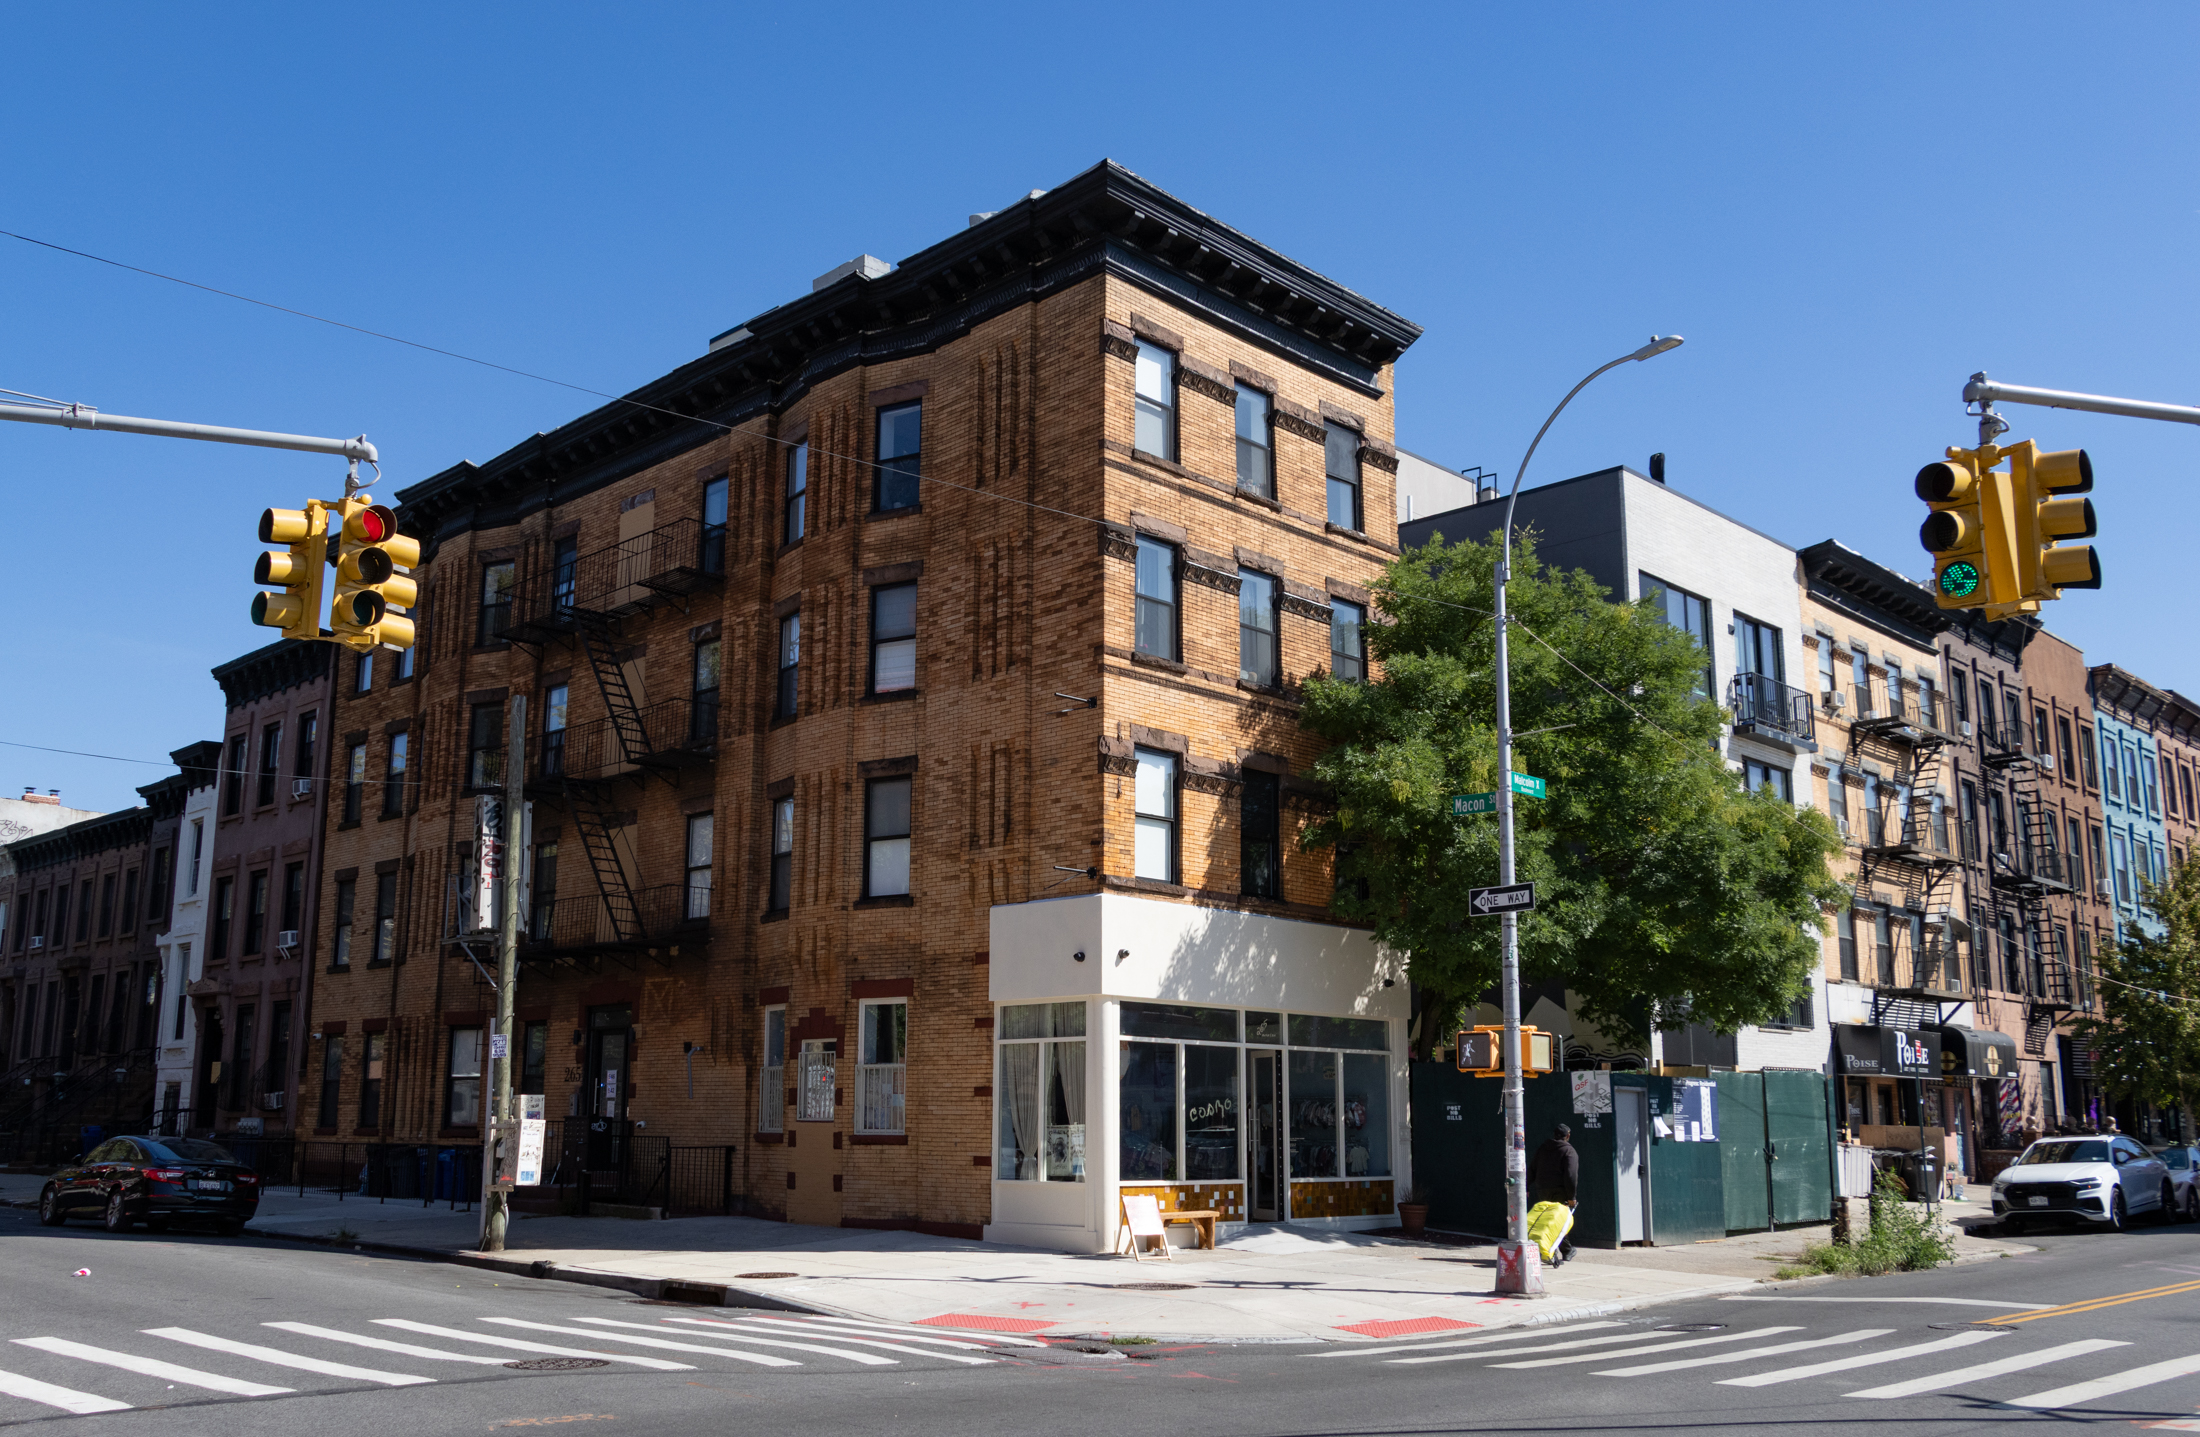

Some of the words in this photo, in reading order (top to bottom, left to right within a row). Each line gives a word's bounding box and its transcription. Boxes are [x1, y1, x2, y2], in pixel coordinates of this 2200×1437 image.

[1514, 774, 1535, 788] Malcolm
[1535, 780, 1540, 789] X
[1455, 798, 1485, 813] Macon
[1488, 794, 1496, 804] St
[1480, 895, 1499, 907] ONE
[1507, 891, 1526, 904] WAY
[1256, 1018, 1269, 1036] 265
[1844, 1054, 1879, 1069] POISE
[564, 1067, 581, 1082] 265
[1574, 1078, 1589, 1092] QSF
